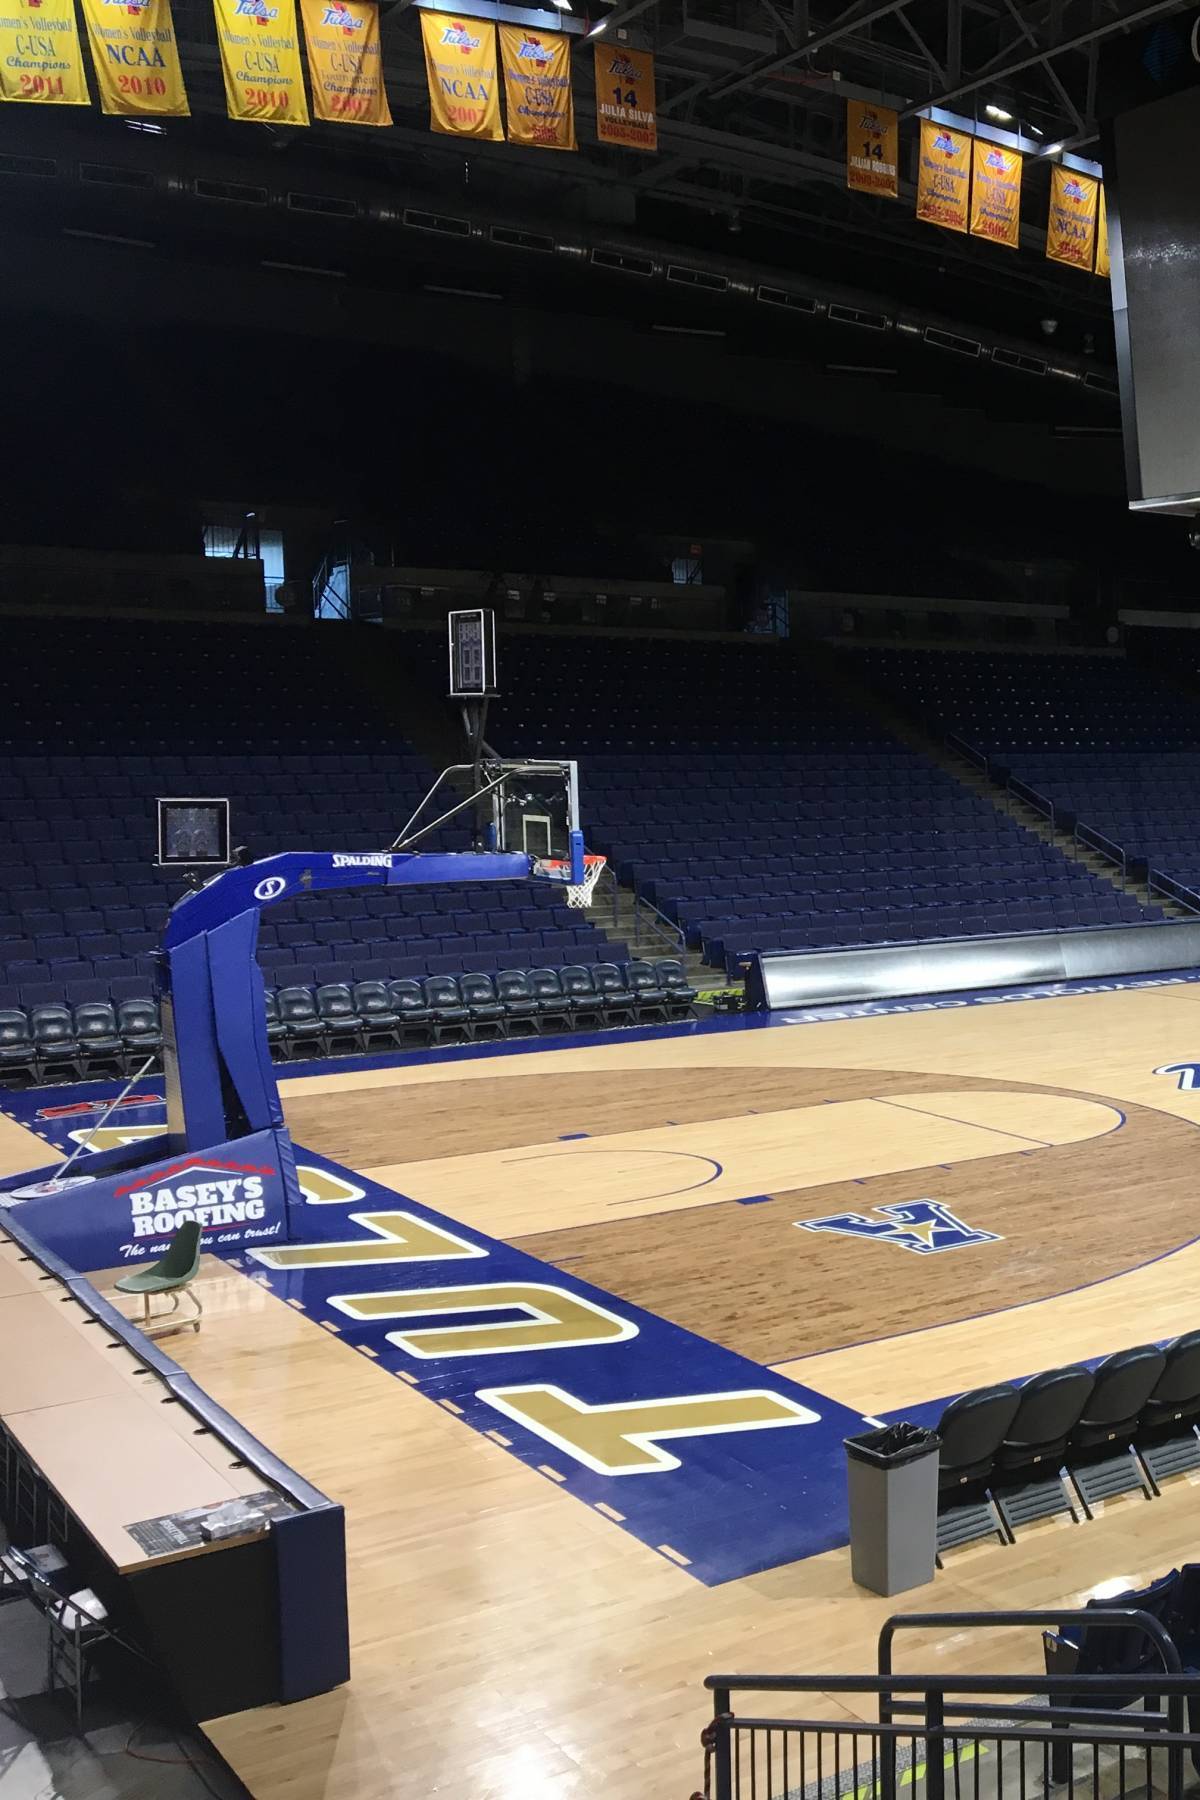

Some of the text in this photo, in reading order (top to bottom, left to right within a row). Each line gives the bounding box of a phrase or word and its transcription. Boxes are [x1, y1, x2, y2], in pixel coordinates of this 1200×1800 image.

[234, 0, 279, 18] Tulsa
[321, 8, 364, 28] Tulsa
[16, 35, 56, 57] C-USA
[441, 28, 480, 48] Tulsa
[6, 56, 71, 72] Champions
[106, 43, 166, 68] NCAA
[244, 51, 280, 73] C-USA
[20, 74, 65, 96] 2011
[118, 75, 166, 96] 2010
[236, 70, 294, 85] Champions
[323, 81, 378, 97] Champions
[440, 77, 488, 100] NCAA
[612, 87, 638, 108] 14
[245, 88, 289, 112] 2010
[600, 103, 654, 123] JULIA SILVA
[863, 141, 883, 160] 14
[1055, 217, 1087, 241] NCAA
[332, 854, 392, 868] SPALDING
[781, 1000, 967, 1024] CENTER
[129, 1176, 264, 1215] BASEY'S
[132, 1199, 265, 1237] ROOFING
[119, 1244, 146, 1258] The
[218, 1232, 241, 1243] can
[244, 1221, 281, 1238] trust!
